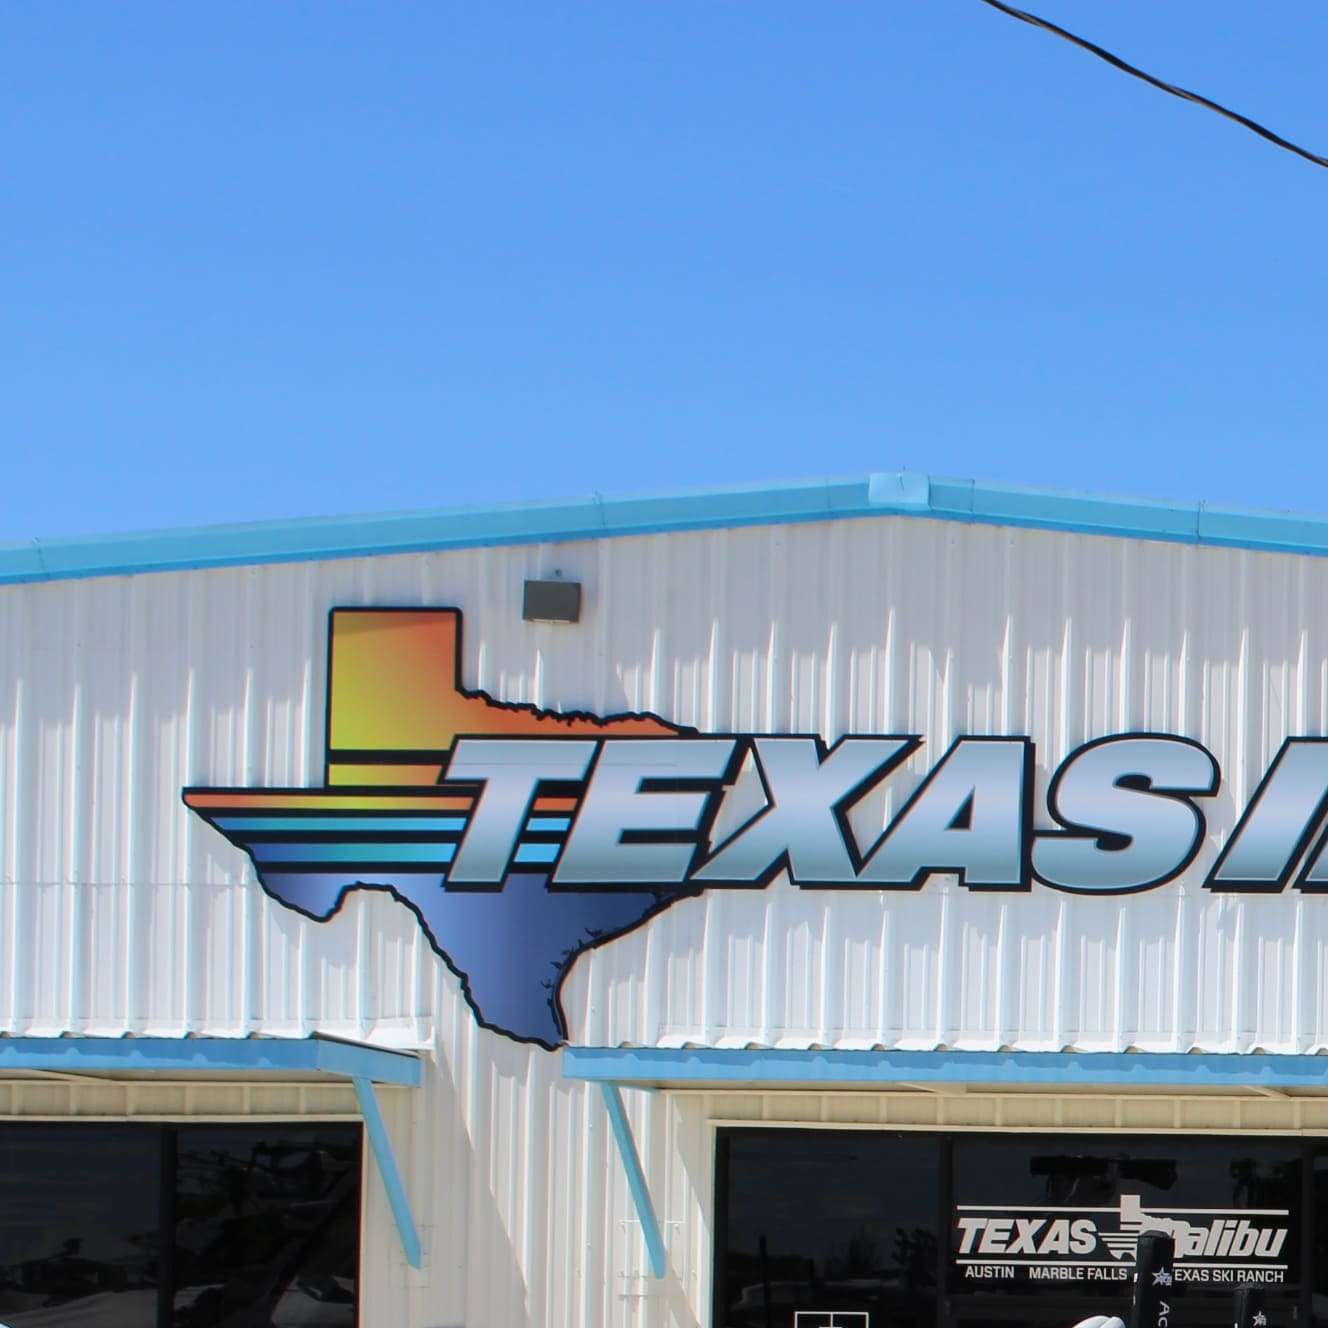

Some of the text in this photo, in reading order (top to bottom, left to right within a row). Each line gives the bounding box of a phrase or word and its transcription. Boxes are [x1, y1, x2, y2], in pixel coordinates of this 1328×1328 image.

[438, 731, 1222, 894] TEXAS
[957, 1217, 1098, 1254] TEXAS
[965, 1266, 1284, 1283] AUSTIN MARBLE FALLS EXAS SKI RANCH
